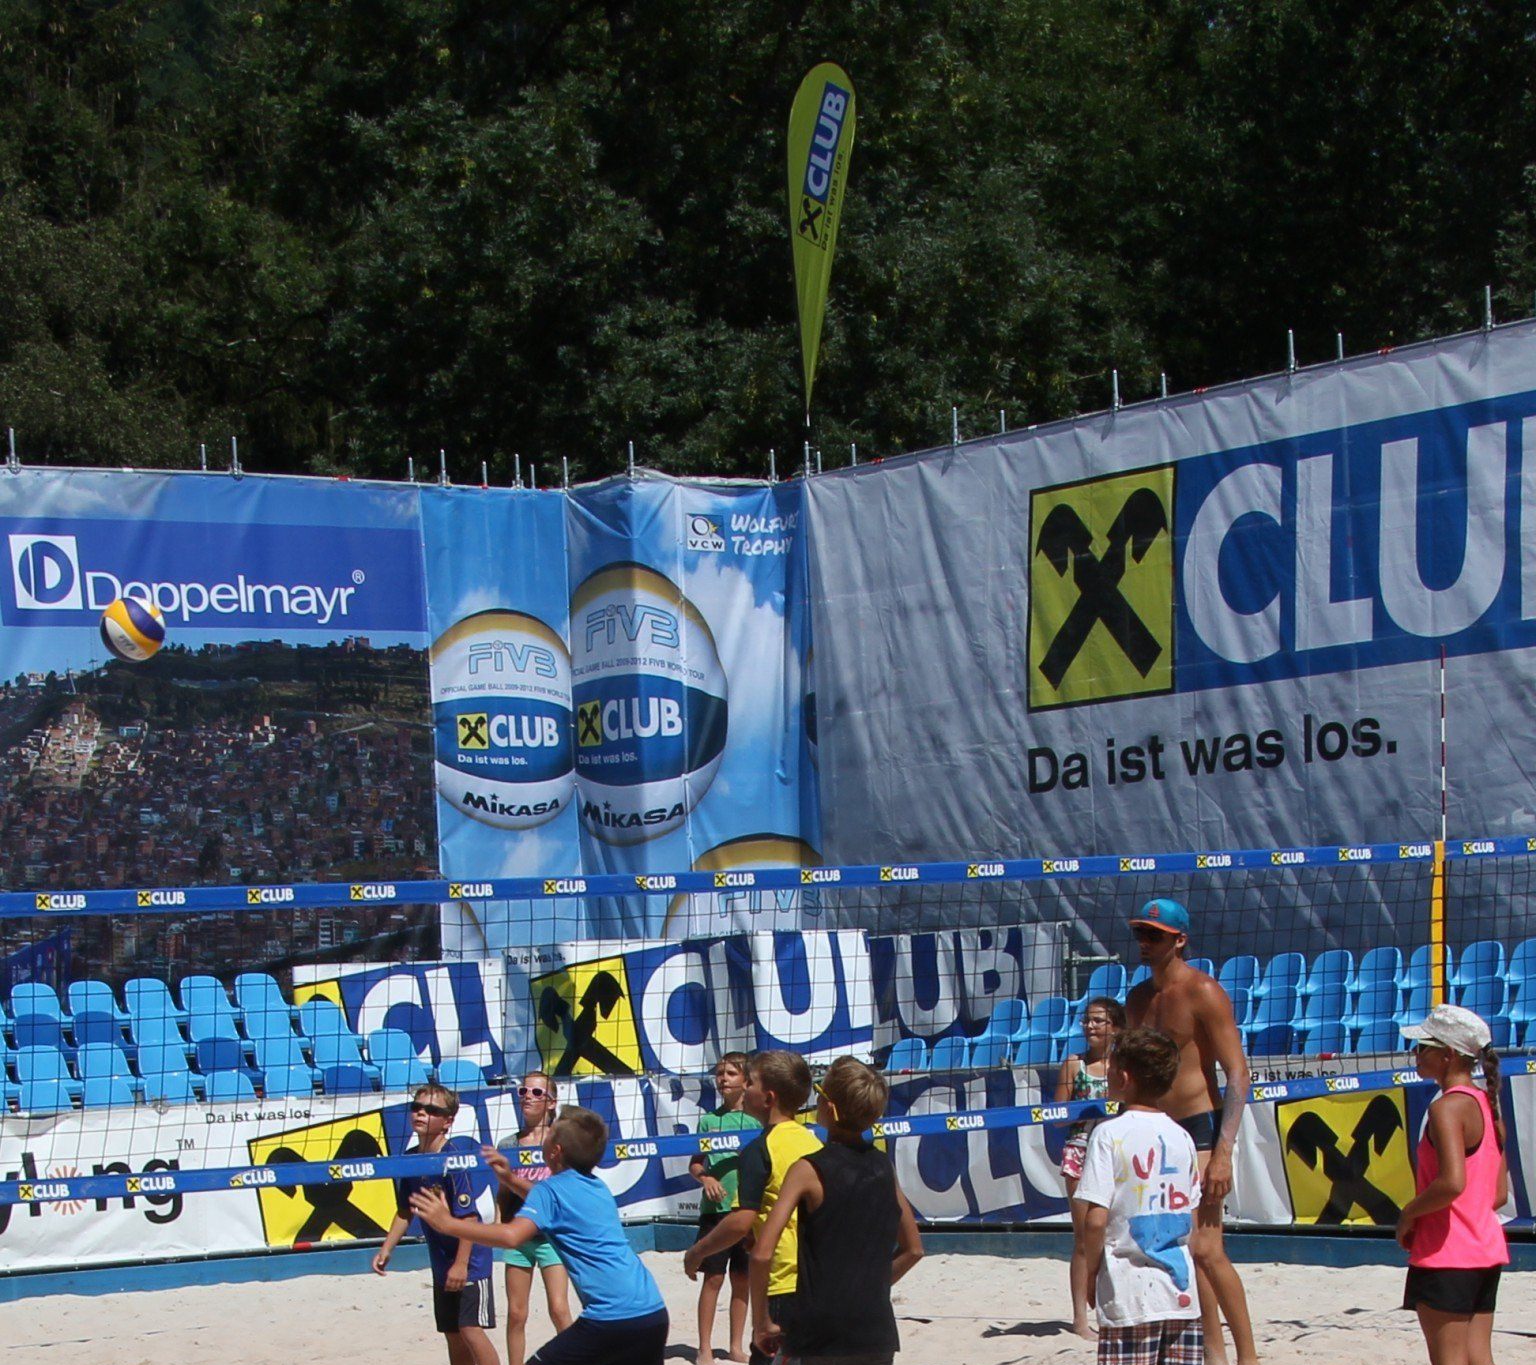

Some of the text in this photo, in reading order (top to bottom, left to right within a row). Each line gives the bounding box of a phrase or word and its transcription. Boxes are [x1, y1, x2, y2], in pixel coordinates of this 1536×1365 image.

[807, 92, 846, 196] CLUB
[689, 540, 723, 550] VCW
[731, 536, 793, 557] TROPHY
[1183, 416, 1536, 664] CLU
[602, 697, 683, 741] CLUB
[489, 714, 560, 748] CLUB
[458, 754, 528, 765] Da ist was los.
[1028, 715, 1398, 794] Da ist was los.
[1350, 848, 1372, 860] CLUB
[1408, 844, 1431, 857] CLUB
[1473, 842, 1495, 853] CLUB
[1130, 858, 1155, 870] CLUB
[1206, 854, 1231, 867] CLUB
[1280, 852, 1305, 864] CLUB
[977, 864, 1004, 876] CLUB
[1053, 860, 1079, 872] CLUB
[726, 873, 755, 886] CLUB
[811, 869, 841, 882] CLUB
[891, 867, 919, 880] CLUB
[555, 880, 587, 893] CLUB
[646, 876, 676, 890] CLUB
[260, 888, 294, 902] CLUB
[363, 885, 396, 898] CLUB
[461, 884, 493, 897] CLUB
[50, 894, 87, 908] CLUB
[151, 891, 186, 905] CLUB
[1264, 1068, 1282, 1082] ist
[1335, 1077, 1360, 1090] CLUB
[1263, 1085, 1288, 1099] CLUB
[206, 1108, 315, 1124] Da ist was los.
[1042, 1107, 1068, 1121] CLUB
[883, 1121, 911, 1134] CLUB
[957, 1115, 984, 1128] CLUB
[627, 1142, 657, 1156] CLUB
[711, 1136, 740, 1150] CLUB
[447, 1155, 478, 1169] CLUB
[342, 1163, 375, 1177] CLUB
[140, 1177, 175, 1191] CLUB
[242, 1171, 277, 1184] CLUB
[33, 1183, 70, 1198] CLUB
